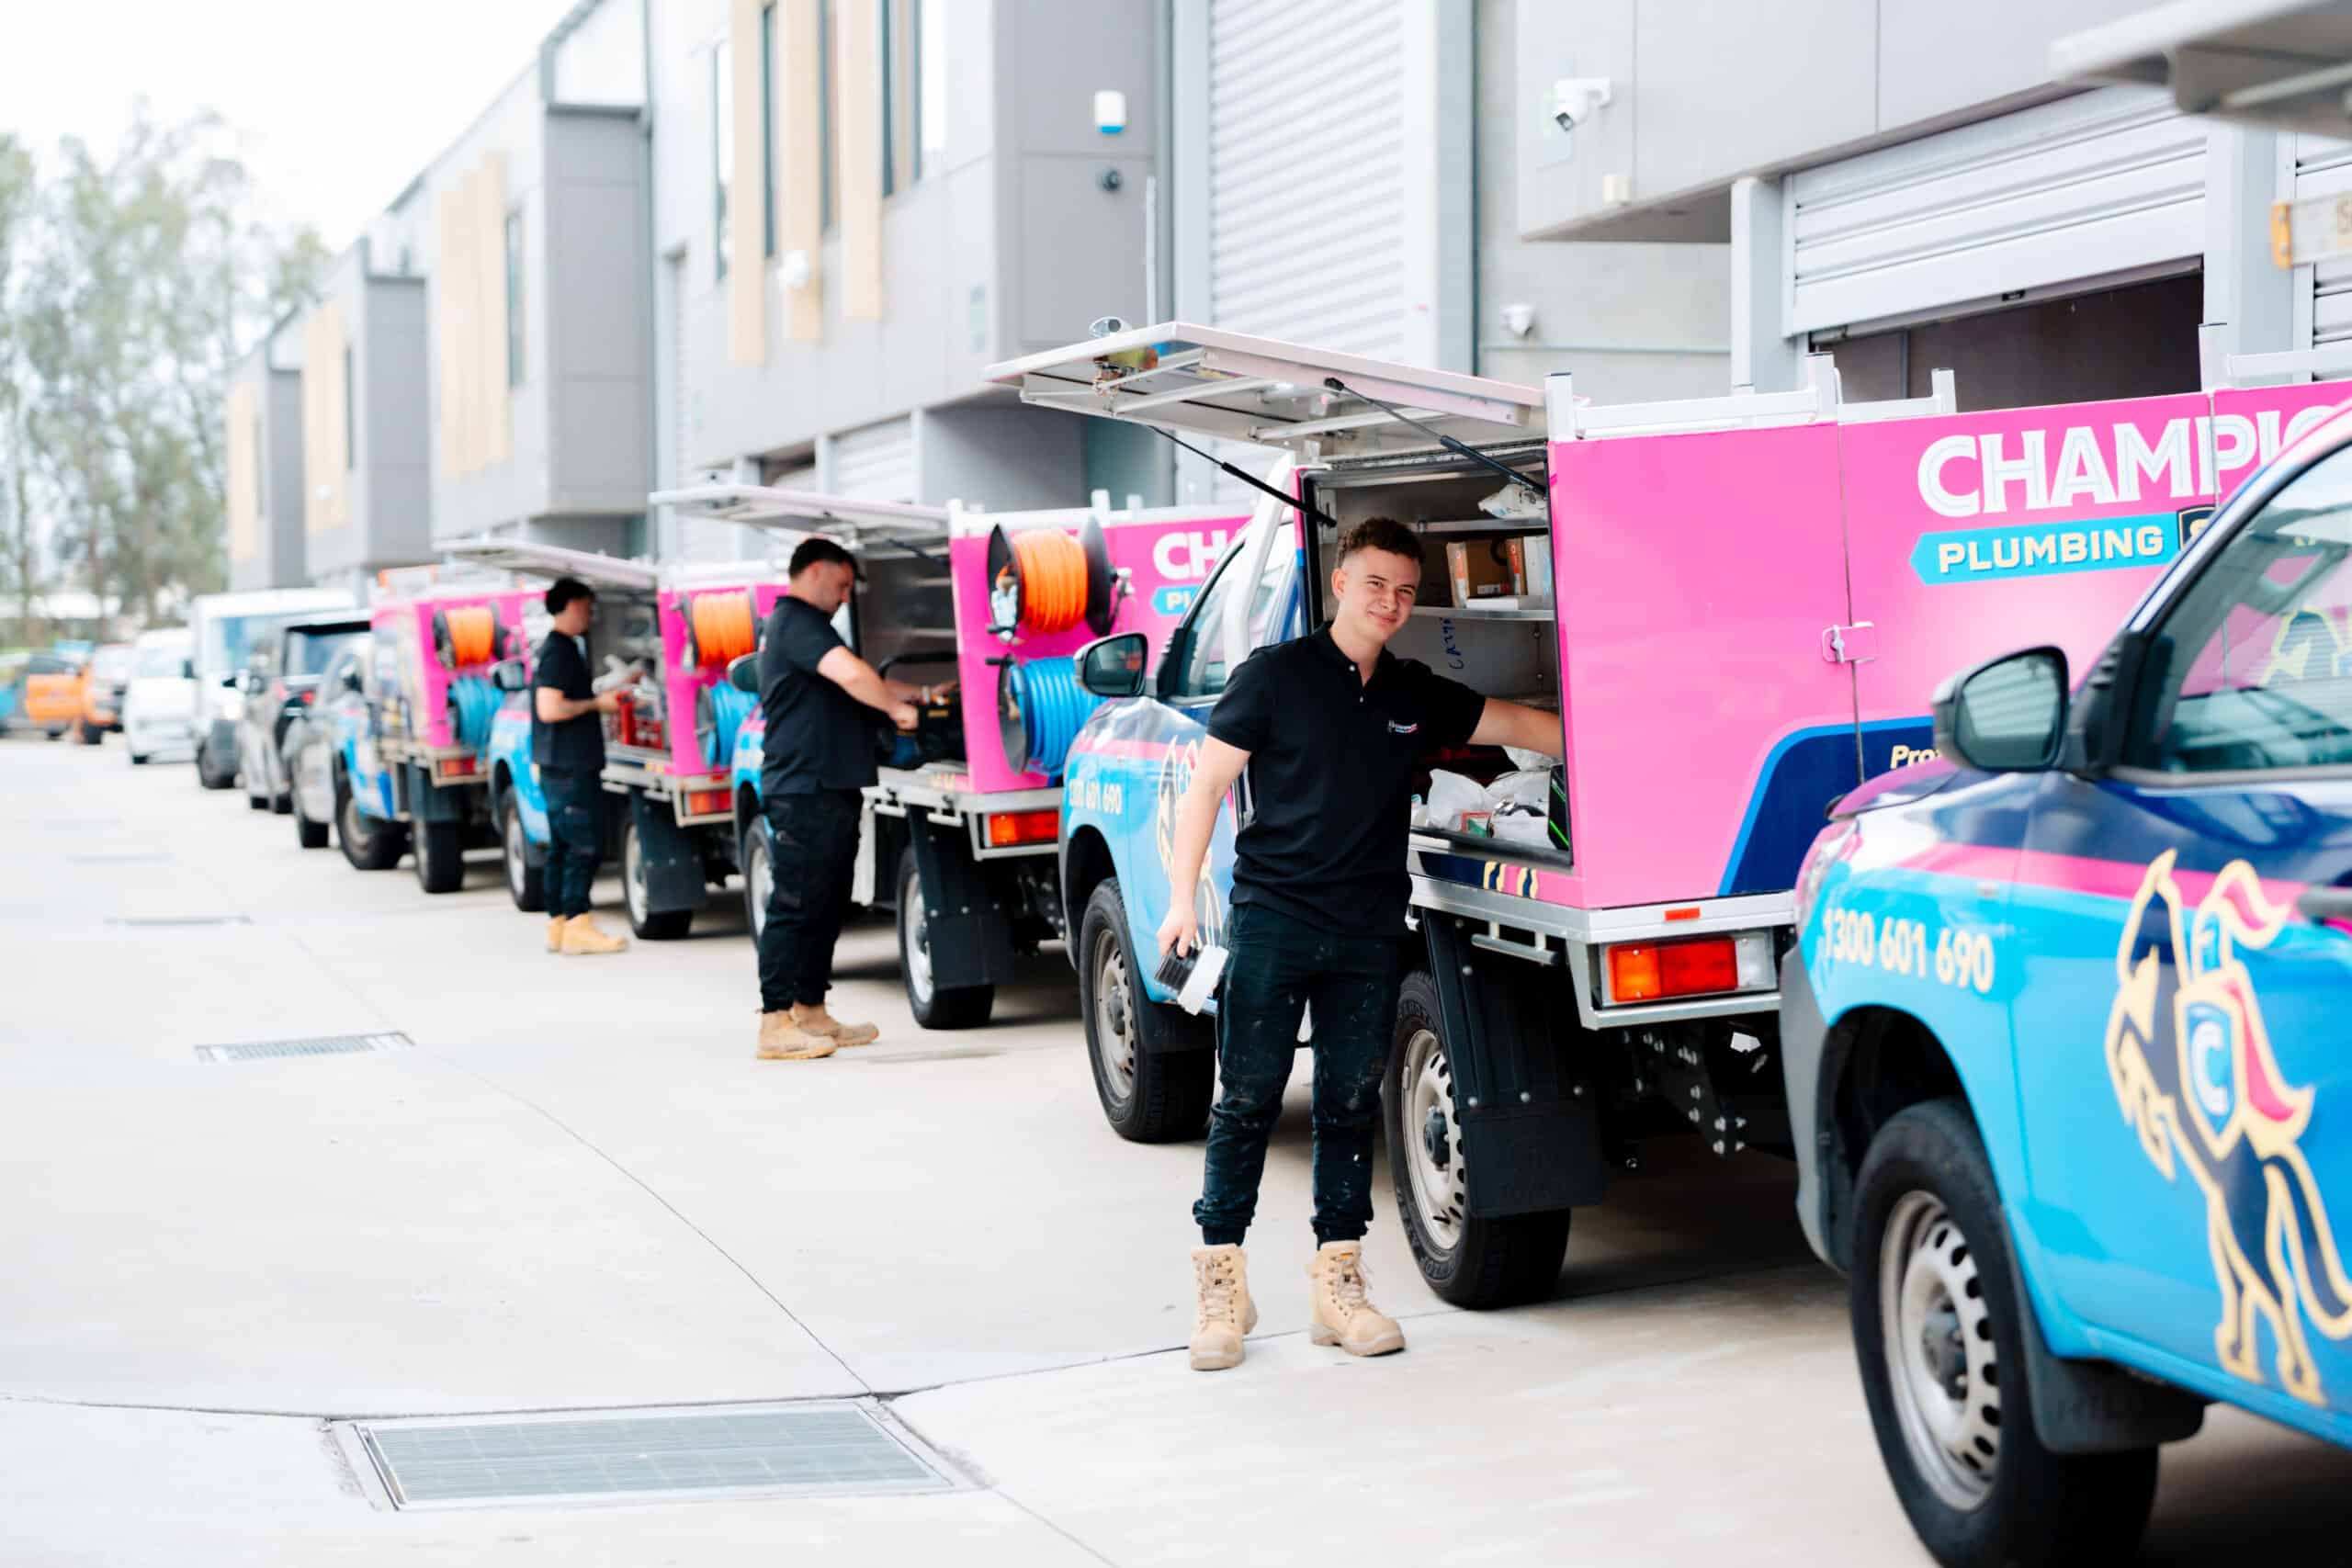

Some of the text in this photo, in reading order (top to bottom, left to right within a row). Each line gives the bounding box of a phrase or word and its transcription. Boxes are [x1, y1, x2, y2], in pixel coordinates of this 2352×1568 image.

[1938, 525, 2164, 574] PLUMBING
[1890, 744, 1941, 770] Pro
[1823, 908, 1996, 993] 1300 601 690
